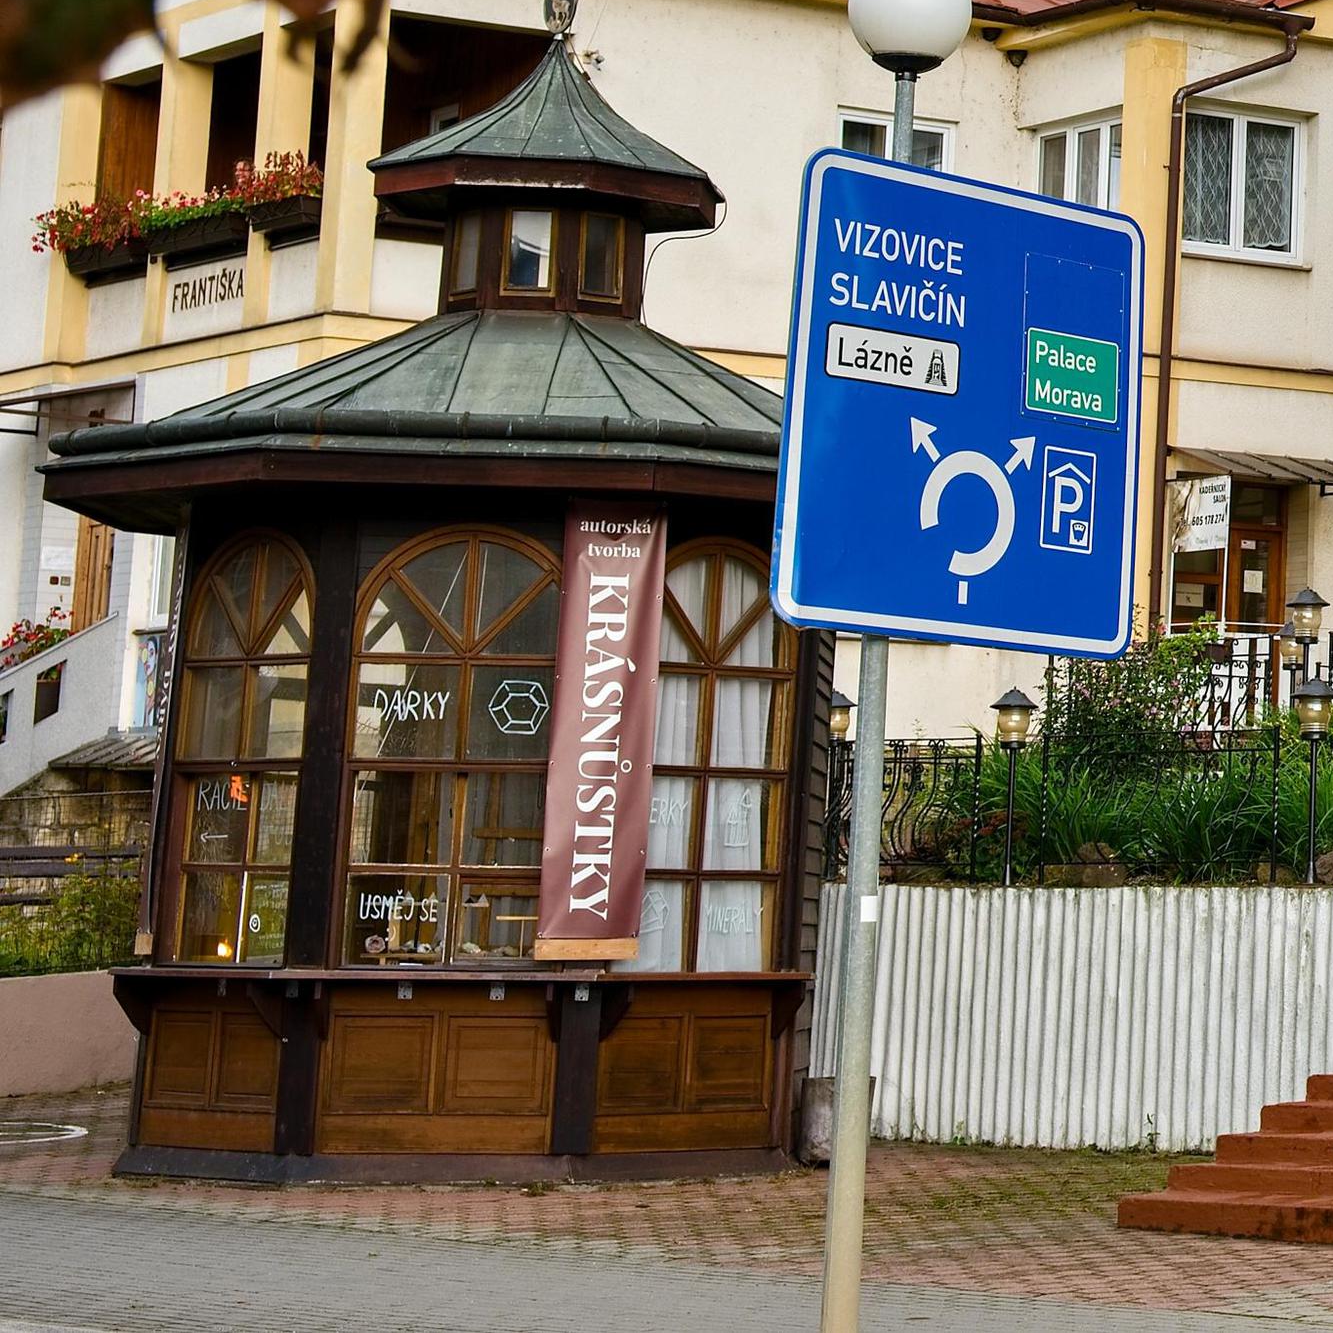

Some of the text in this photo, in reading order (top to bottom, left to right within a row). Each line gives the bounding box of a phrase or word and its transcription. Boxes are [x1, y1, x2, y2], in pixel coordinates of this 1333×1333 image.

[834, 218, 964, 275] VIZOVICE
[172, 268, 244, 313] FRANTIŠKA
[829, 272, 966, 328] SLAVIČÍN
[838, 337, 913, 376] Lázně
[1035, 340, 1097, 373] Palace
[1035, 378, 1102, 412] Morava
[580, 519, 652, 534] autorská
[1191, 516, 1203, 526] 605
[588, 543, 641, 558] tvorba
[568, 572, 637, 921] KRÁSNŮSTKY
[649, 797, 689, 827] ERKY
[359, 889, 438, 923] USMĚJ SE
